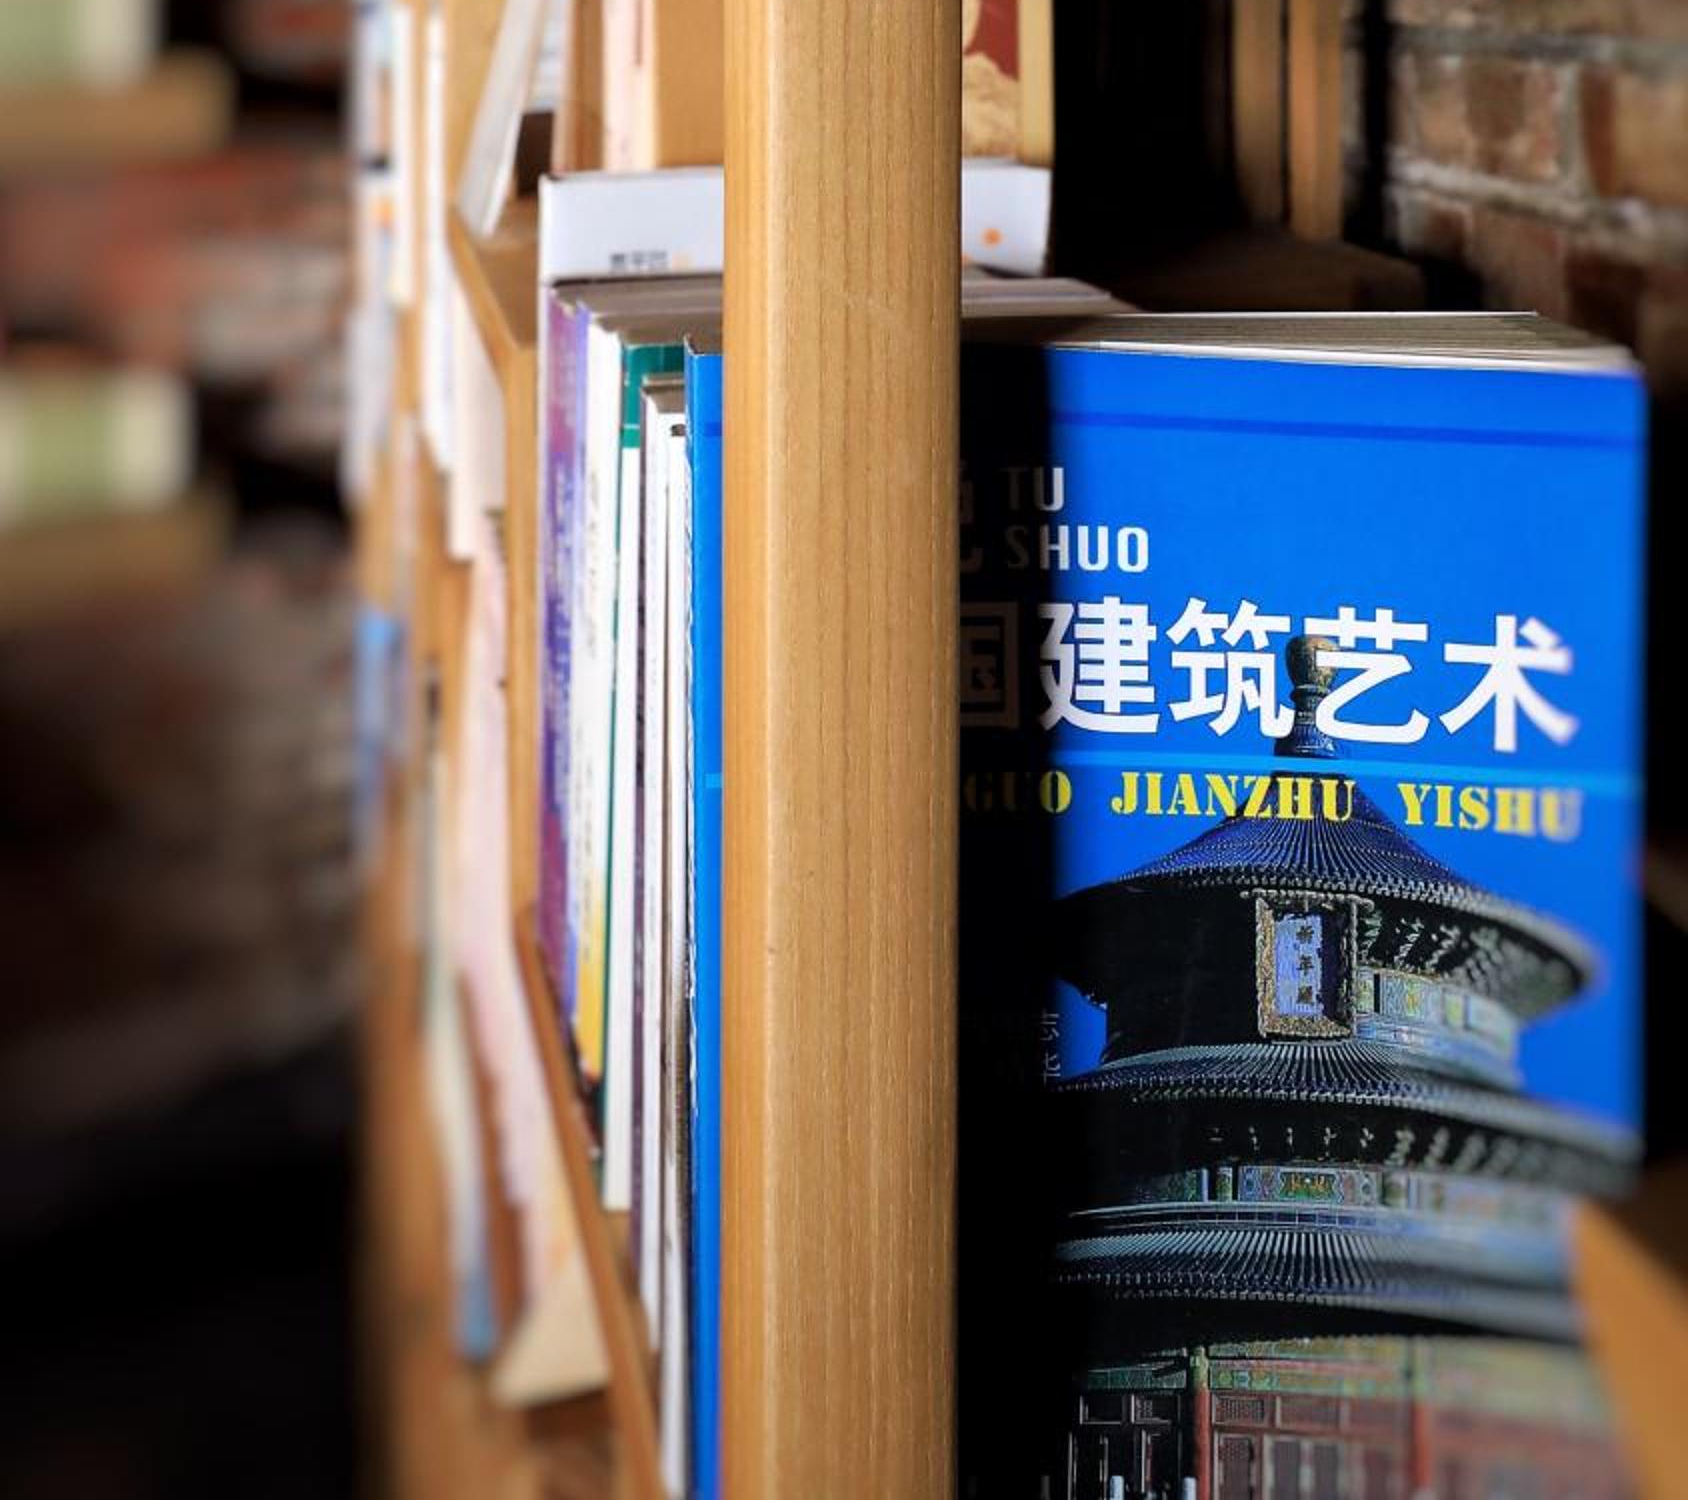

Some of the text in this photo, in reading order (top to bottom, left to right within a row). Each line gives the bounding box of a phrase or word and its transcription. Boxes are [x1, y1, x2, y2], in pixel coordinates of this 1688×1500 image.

[995, 467, 1065, 512] TU
[1003, 525, 1149, 573] SHUO
[1111, 770, 1356, 823] JIANZHU
[1397, 782, 1584, 841] YISHU
